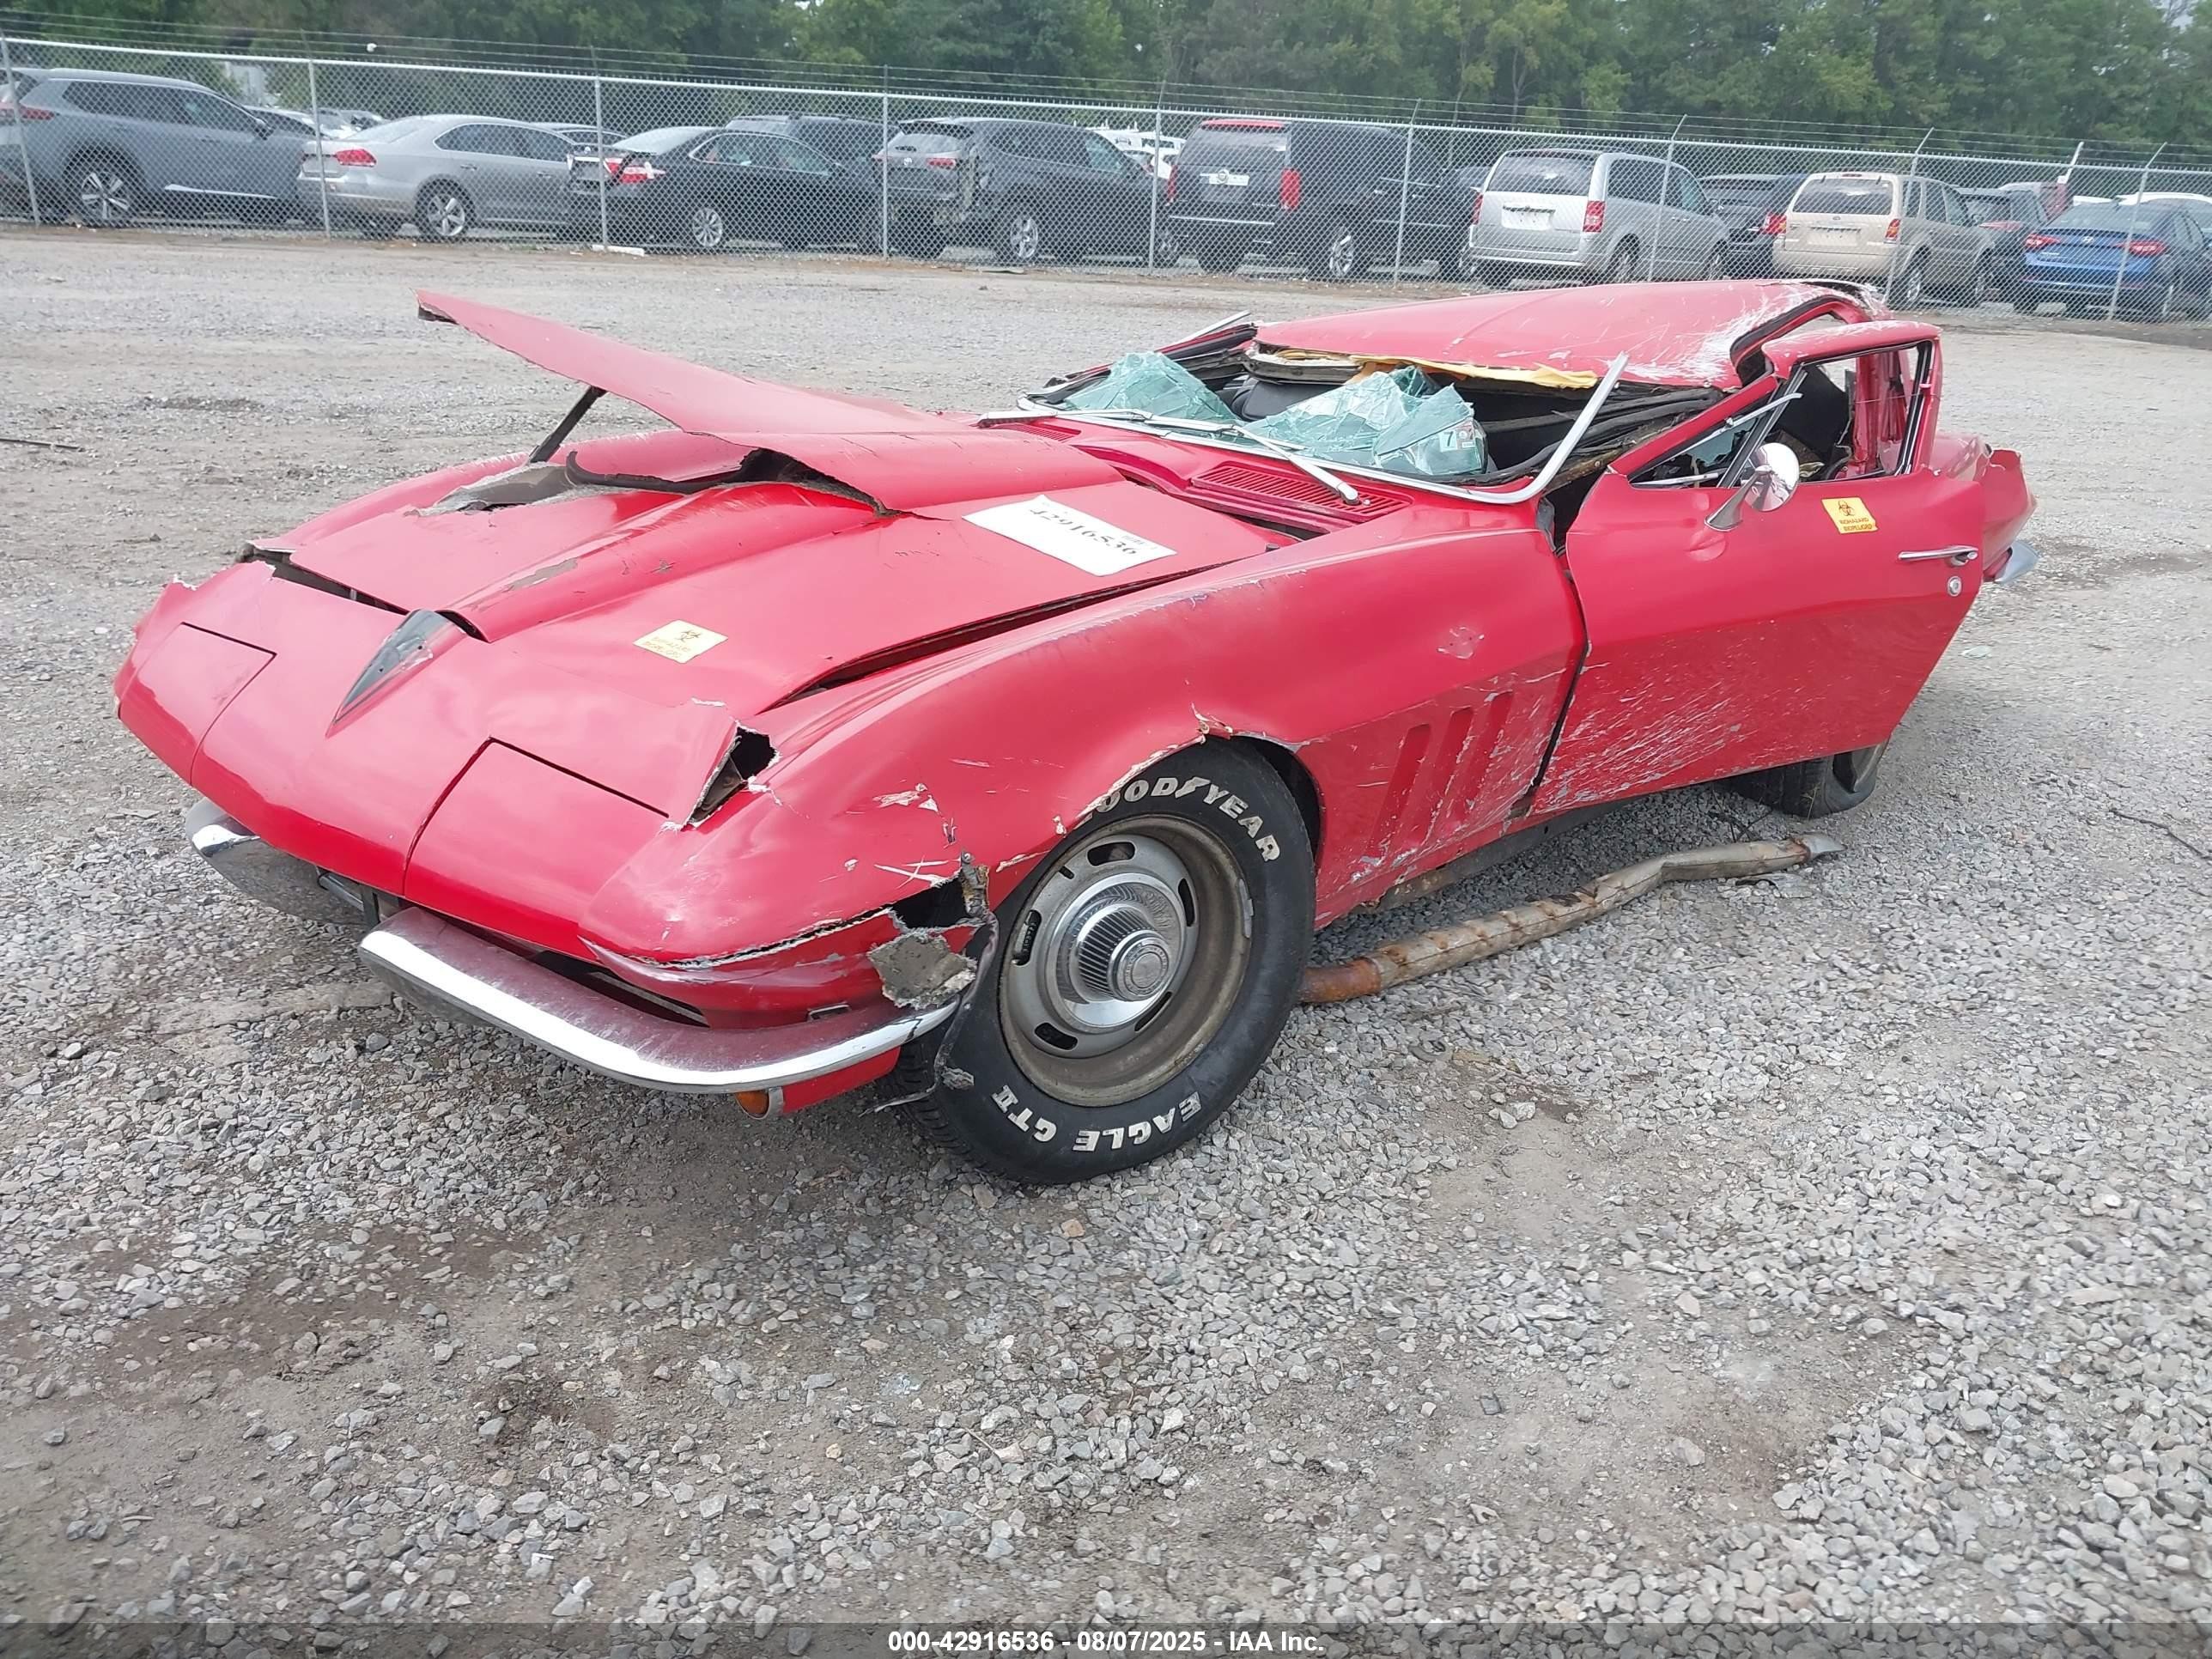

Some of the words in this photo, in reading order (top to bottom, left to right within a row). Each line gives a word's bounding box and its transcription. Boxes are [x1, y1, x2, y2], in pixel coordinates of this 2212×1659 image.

[1073, 776, 1281, 862] OODYEAR
[991, 1085, 1019, 1113] II
[1072, 1091, 1202, 1152] EAGLE
[1007, 1108, 1057, 1143] GT
